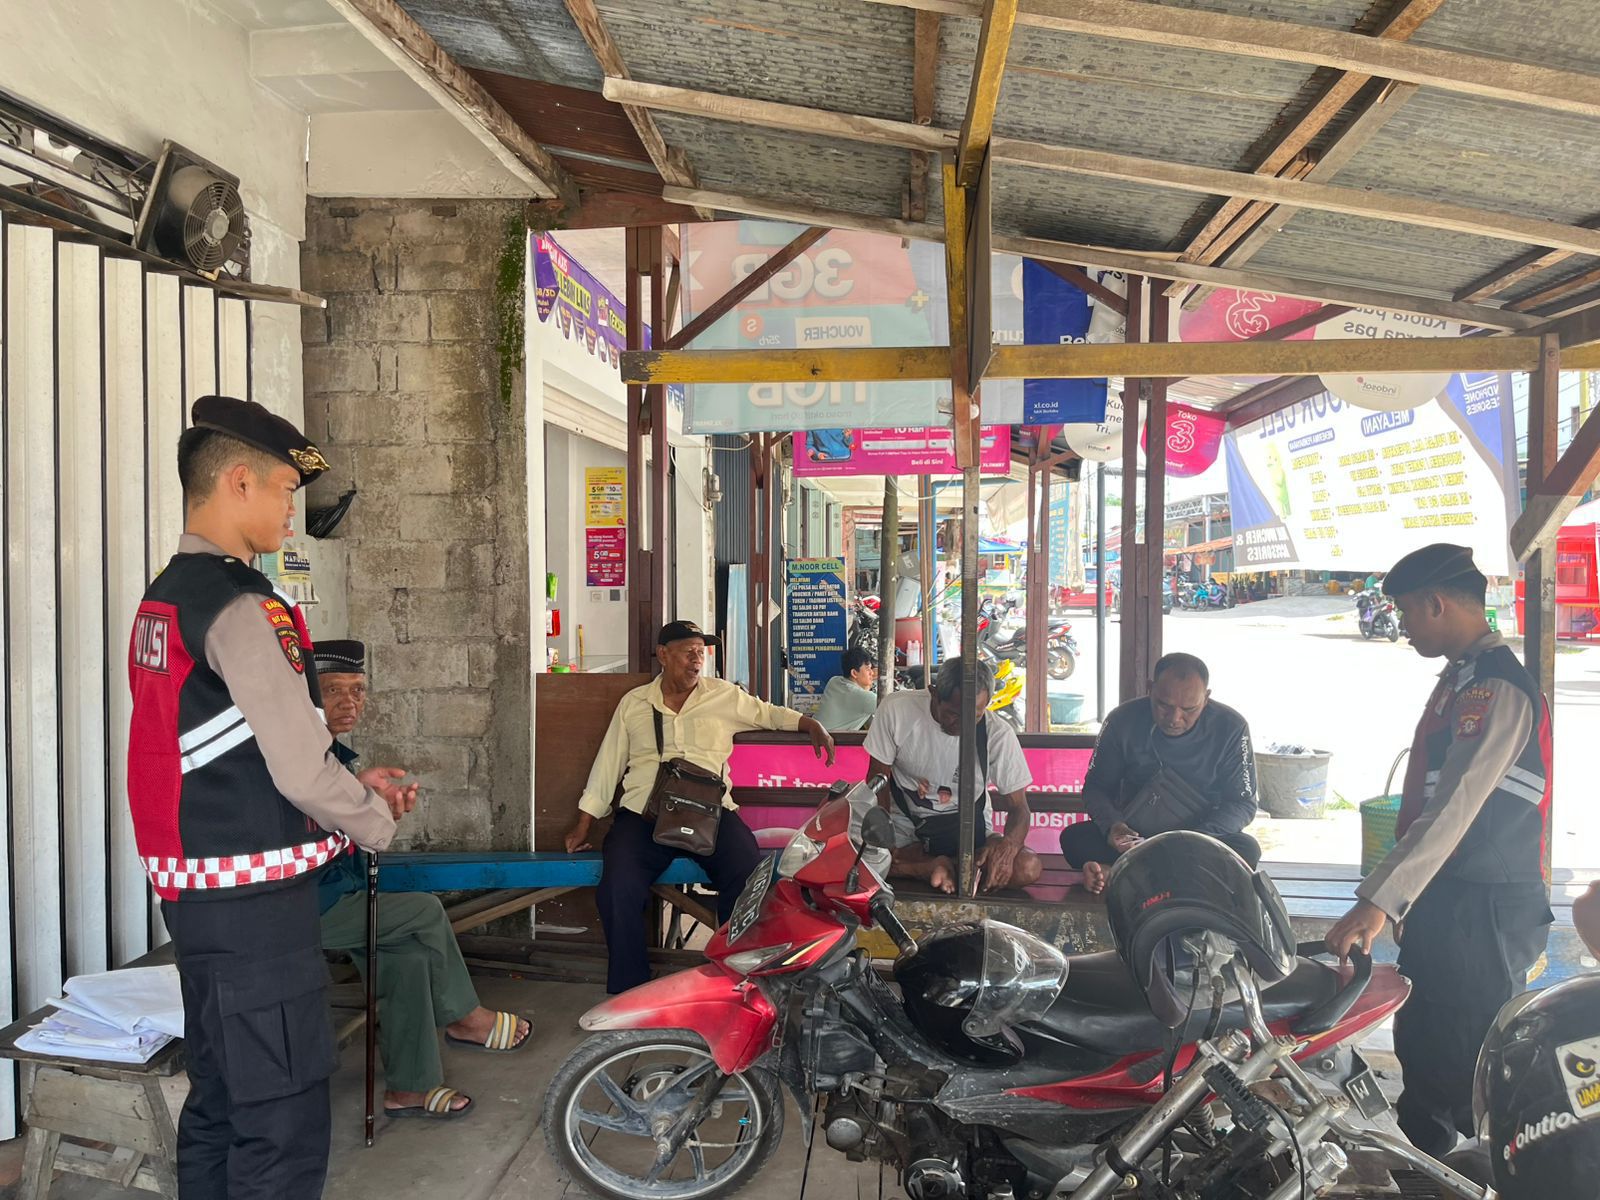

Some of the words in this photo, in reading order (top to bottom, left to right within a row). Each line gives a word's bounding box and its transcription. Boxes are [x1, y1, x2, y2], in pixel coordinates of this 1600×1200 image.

[1033, 401, 1059, 409] xl.co.id
[1176, 409, 1198, 422] Toko
[1096, 424, 1112, 435] Tri.
[792, 563, 820, 571] M.NOOR
[821, 562, 839, 570] CELL
[1352, 1079, 1370, 1100] W
[1503, 1111, 1579, 1161] evolutio
